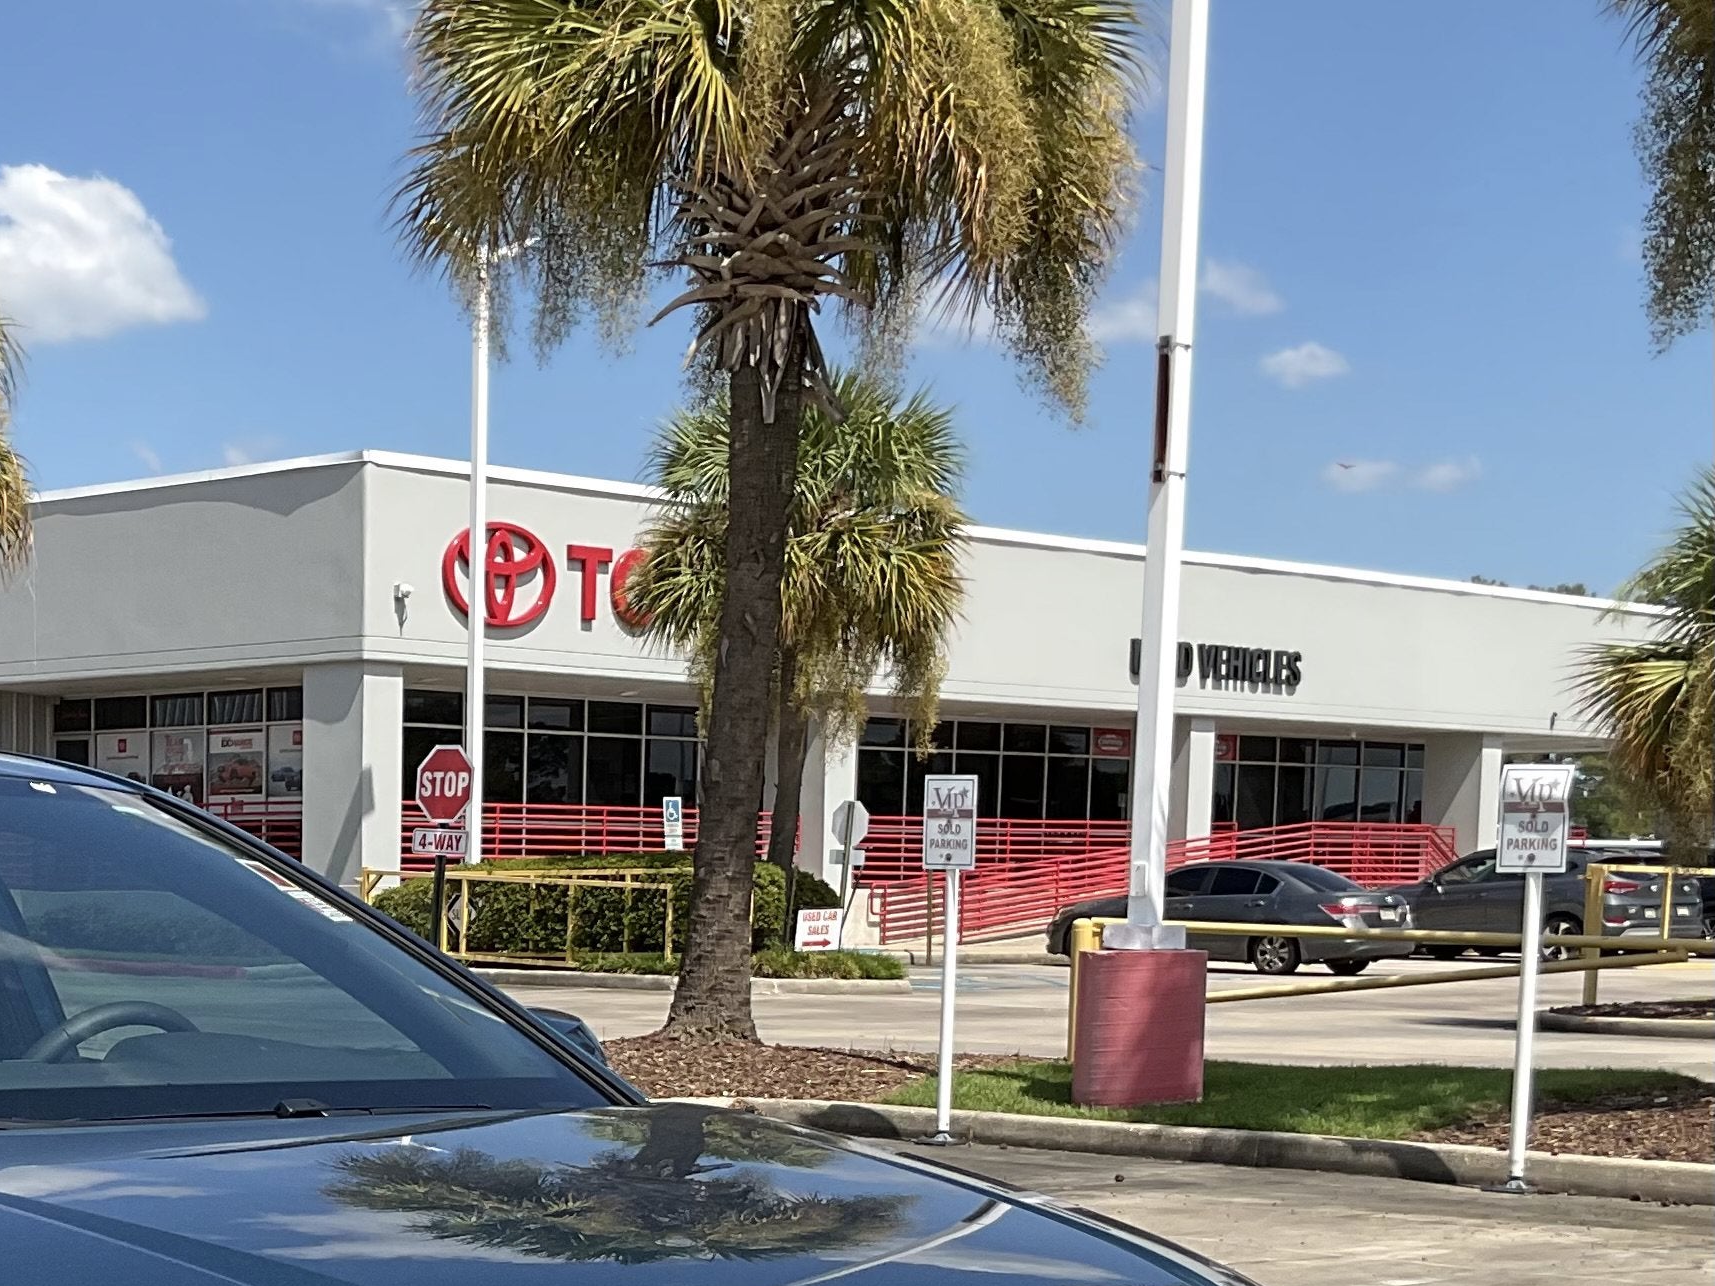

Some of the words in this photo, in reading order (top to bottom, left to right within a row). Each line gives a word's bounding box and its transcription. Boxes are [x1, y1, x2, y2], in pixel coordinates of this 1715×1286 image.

[1130, 638, 1193, 679] UD
[1197, 643, 1302, 687] VEHICLES
[420, 770, 470, 798] STOP
[937, 823, 962, 835] SOLD
[1517, 820, 1549, 833] SOLD
[418, 832, 463, 852] 4-WAY
[929, 838, 968, 850] PARKING
[1506, 837, 1558, 851] PARKING
[802, 911, 821, 922] USED
[823, 910, 838, 921] CAR
[807, 924, 830, 936] SALES
